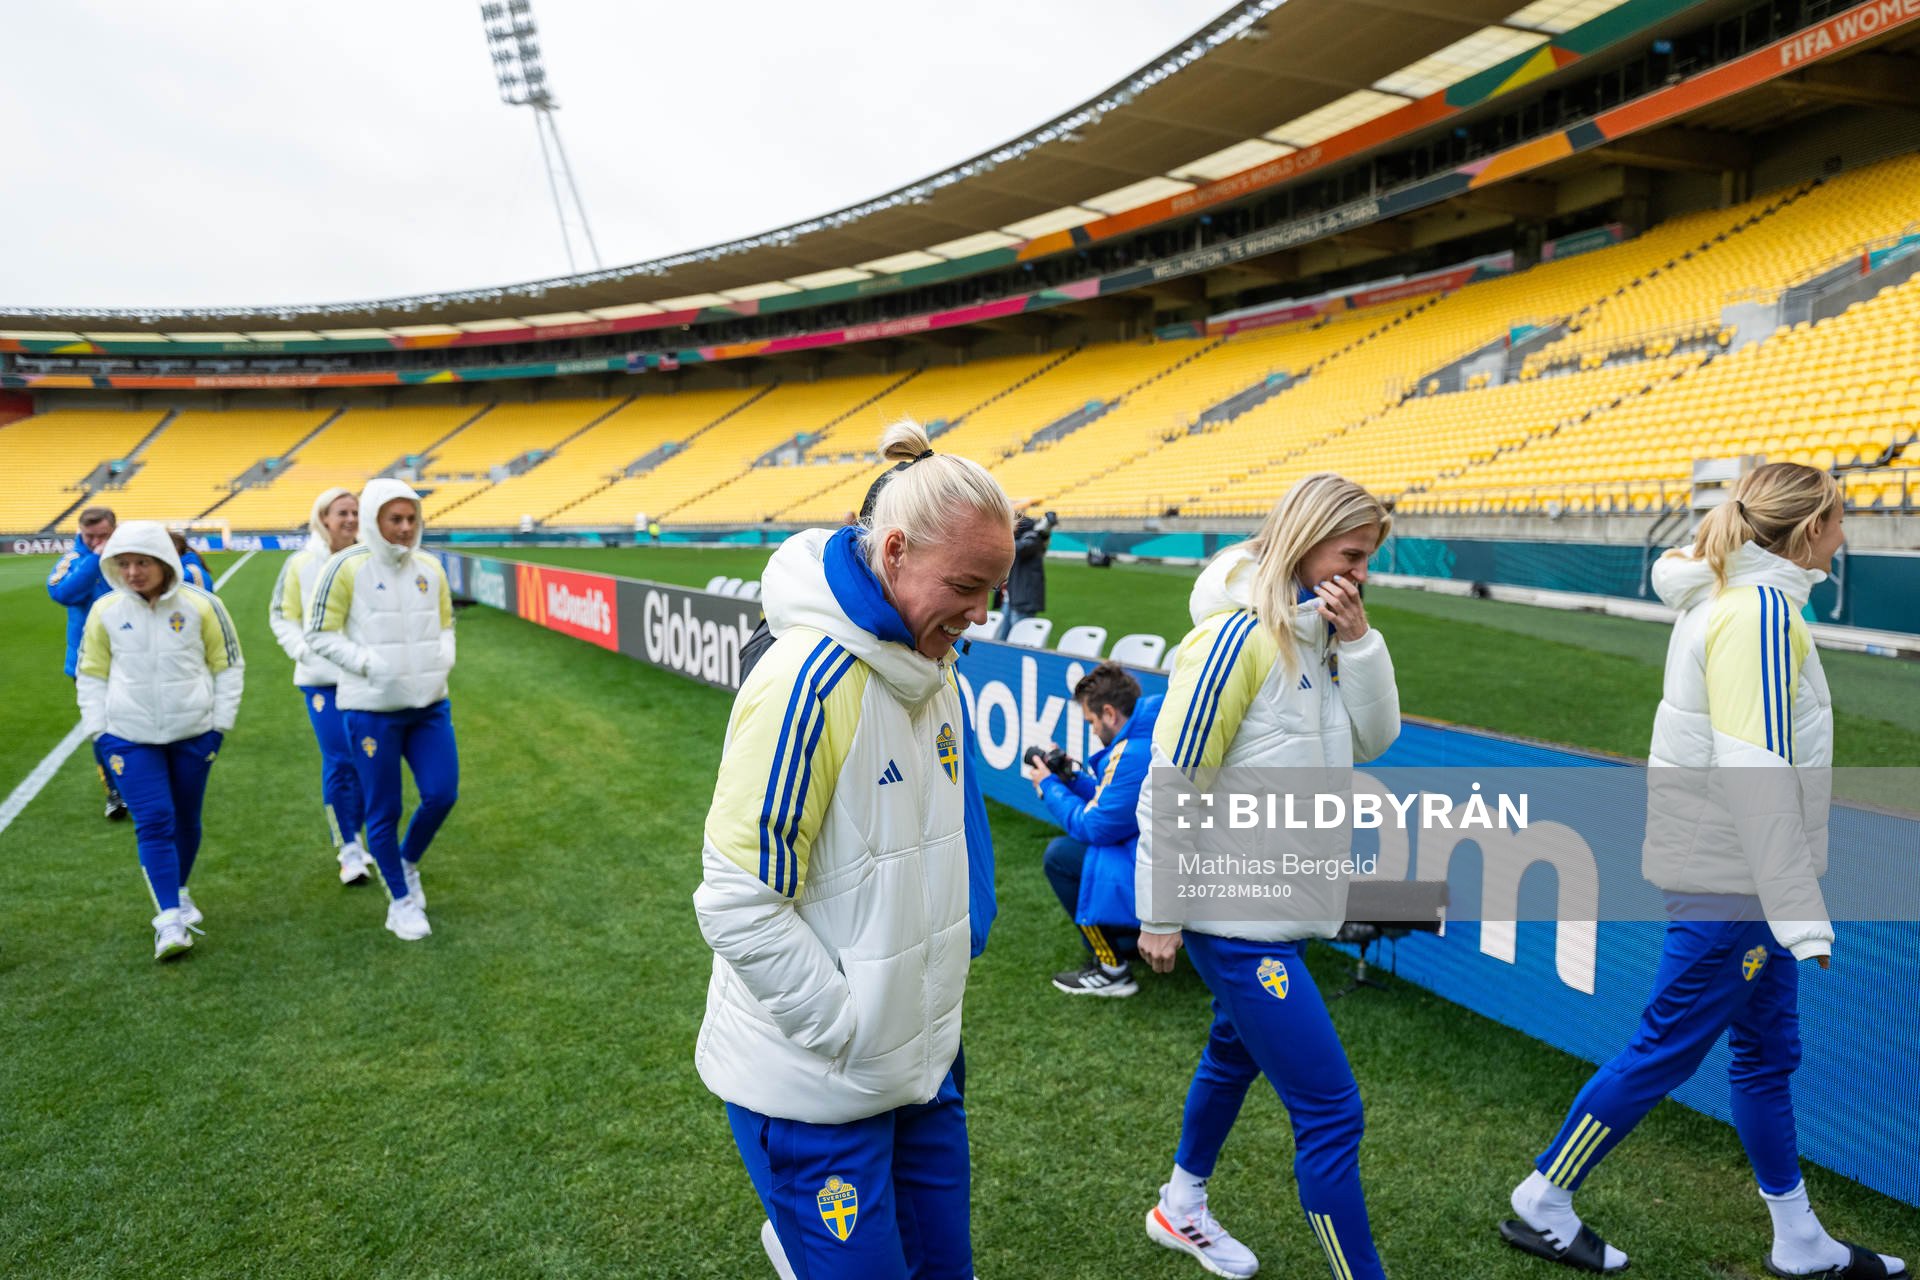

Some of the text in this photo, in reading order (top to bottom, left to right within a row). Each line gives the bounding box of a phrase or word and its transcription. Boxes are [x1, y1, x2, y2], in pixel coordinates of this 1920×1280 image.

[1781, 27, 1833, 66] FIFA
[1153, 250, 1225, 279] WELLINGTON
[14, 539, 74, 554] QATAR
[547, 582, 611, 635] McDonald's
[959, 656, 1106, 782] oki
[822, 1191, 851, 1202] SVERIGE
